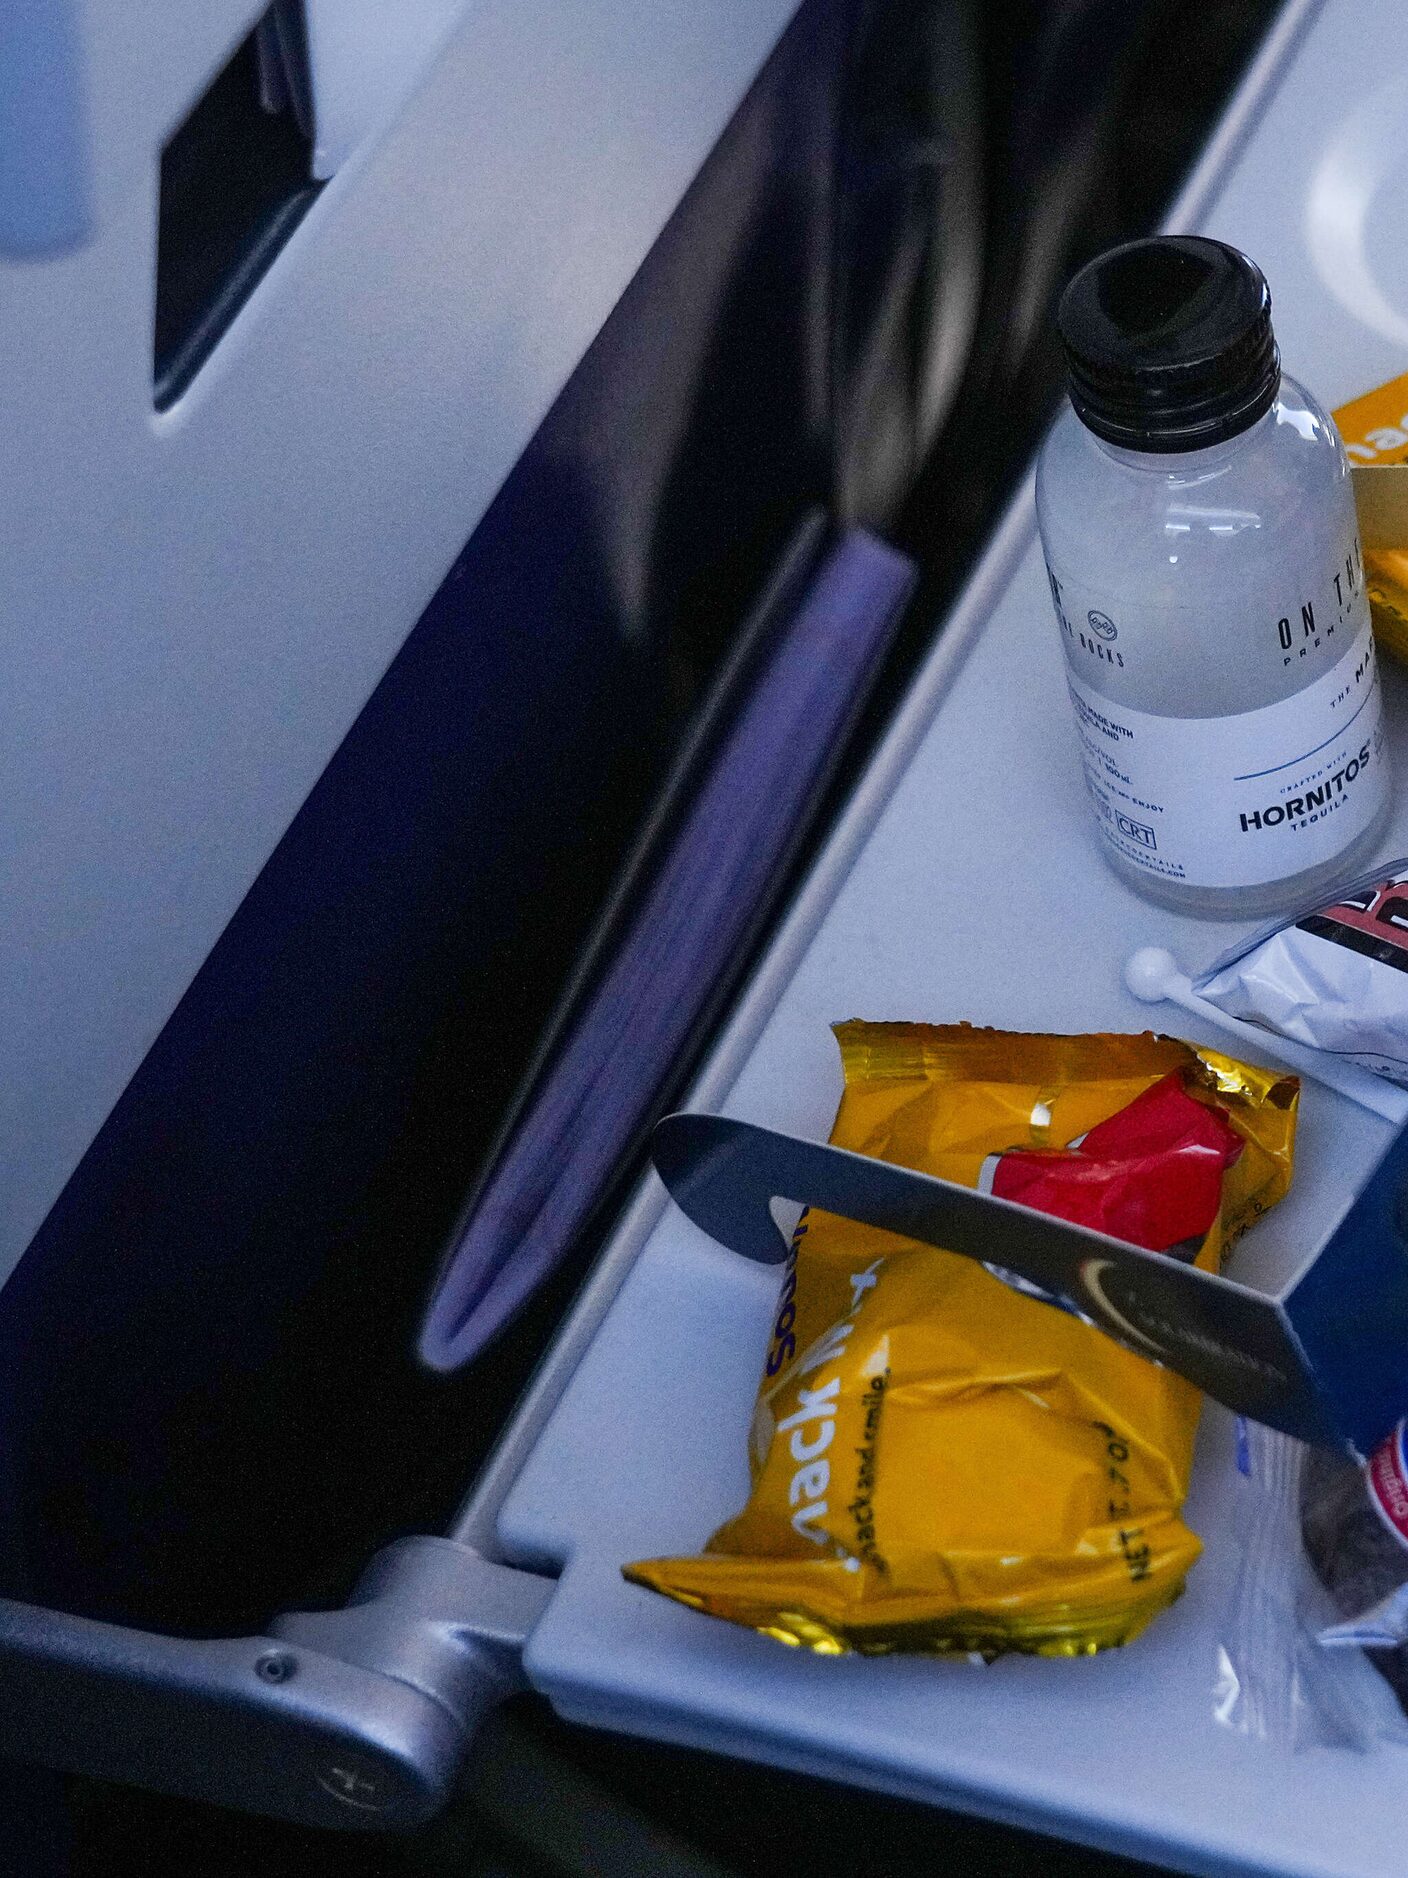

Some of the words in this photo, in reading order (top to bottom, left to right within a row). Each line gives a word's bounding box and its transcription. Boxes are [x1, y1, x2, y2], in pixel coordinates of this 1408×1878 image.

[1278, 602, 1316, 650] ON
[1118, 817, 1152, 845] CRT
[1290, 793, 1349, 832] TEQUILA
